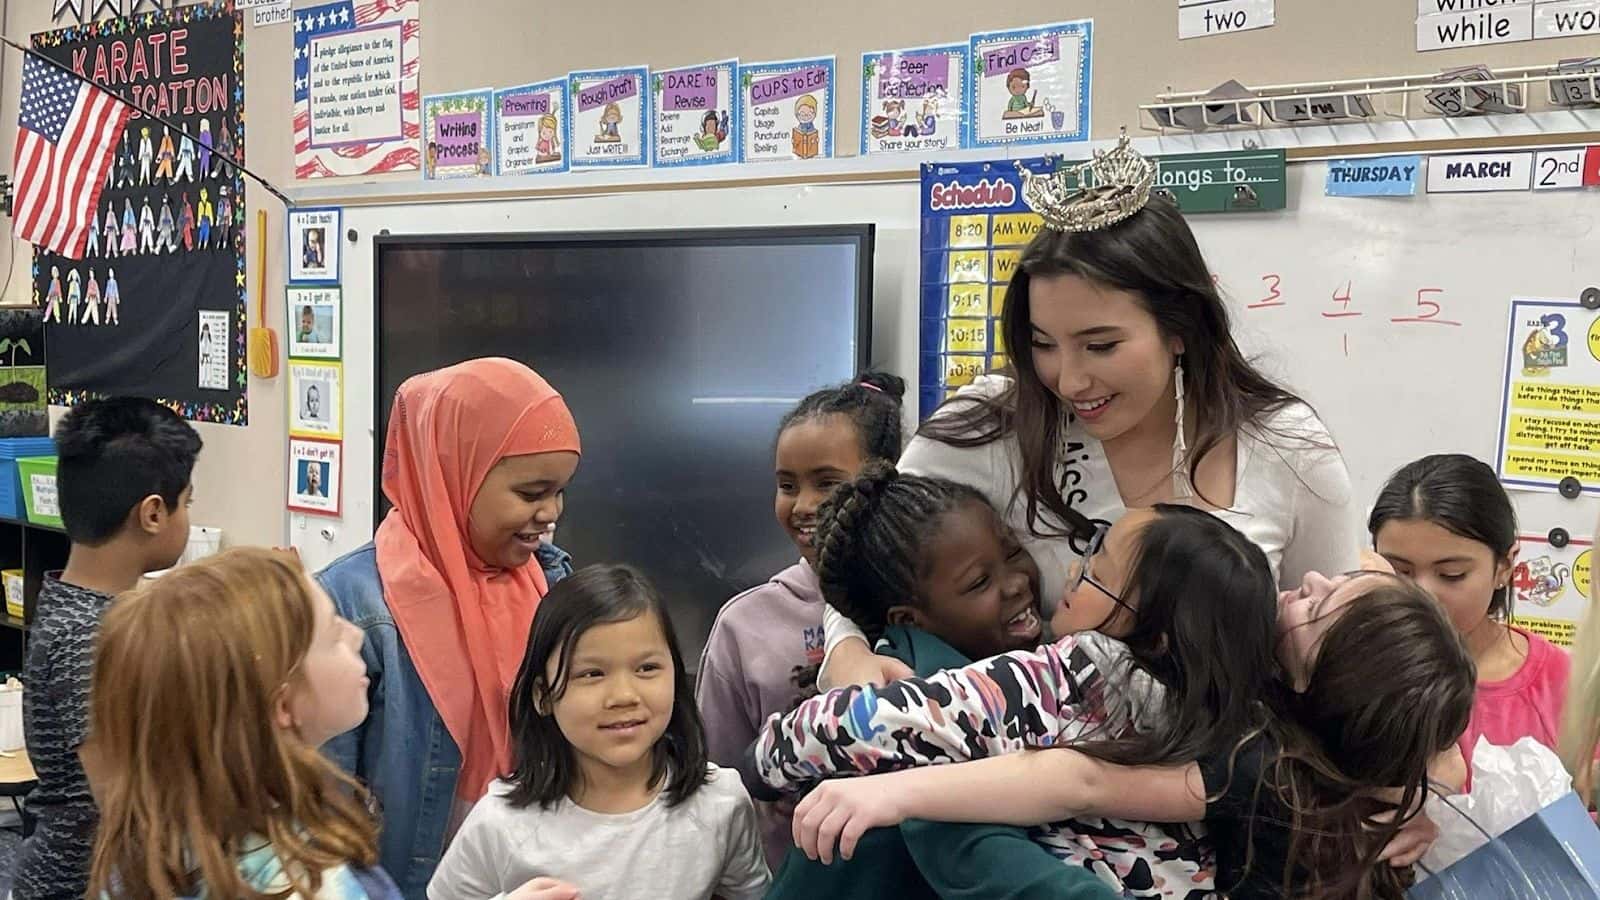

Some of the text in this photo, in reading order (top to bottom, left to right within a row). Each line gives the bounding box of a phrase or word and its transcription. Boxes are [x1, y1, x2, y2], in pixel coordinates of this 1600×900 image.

[256, 6, 291, 23] brother
[1204, 9, 1246, 32] two
[1555, 10, 1600, 32] wo
[1437, 13, 1510, 43] while
[314, 41, 318, 57] I
[72, 28, 189, 86] KARATE
[988, 49, 1017, 70] Final
[900, 61, 929, 76] Peer
[668, 74, 716, 89] DARE to
[793, 77, 804, 89] to
[807, 70, 826, 87] Edit
[581, 78, 633, 107] Rough Draft
[505, 99, 548, 113] Prewriting
[675, 95, 706, 109] Revise
[661, 113, 680, 122] Delete
[754, 107, 780, 117] Capitals
[440, 122, 477, 138] Writing
[661, 125, 673, 133] Add
[754, 119, 776, 130] Usage
[1005, 121, 1043, 134] Be Neat!
[513, 133, 524, 142] and
[661, 135, 691, 146] Rearrange
[754, 130, 790, 141] Punctuation
[437, 142, 479, 160] Process
[586, 144, 601, 155] Just
[754, 143, 778, 154] Spelling
[880, 135, 948, 152] Share your story!
[661, 147, 689, 158] Exchange
[1331, 165, 1415, 184] THURSDAY
[1446, 161, 1511, 180] MARCH
[1539, 153, 1580, 186] 2nd
[931, 179, 1015, 208] Schedule
[955, 220, 1041, 238] 8:20 AM Wo
[953, 294, 981, 307] 9:15
[1262, 274, 1444, 319] 3 4 5
[950, 329, 985, 342] 10:15
[950, 364, 983, 377] 10:30
[1537, 386, 1560, 395] things
[1560, 396, 1583, 404] things
[1513, 456, 1535, 464] spend
